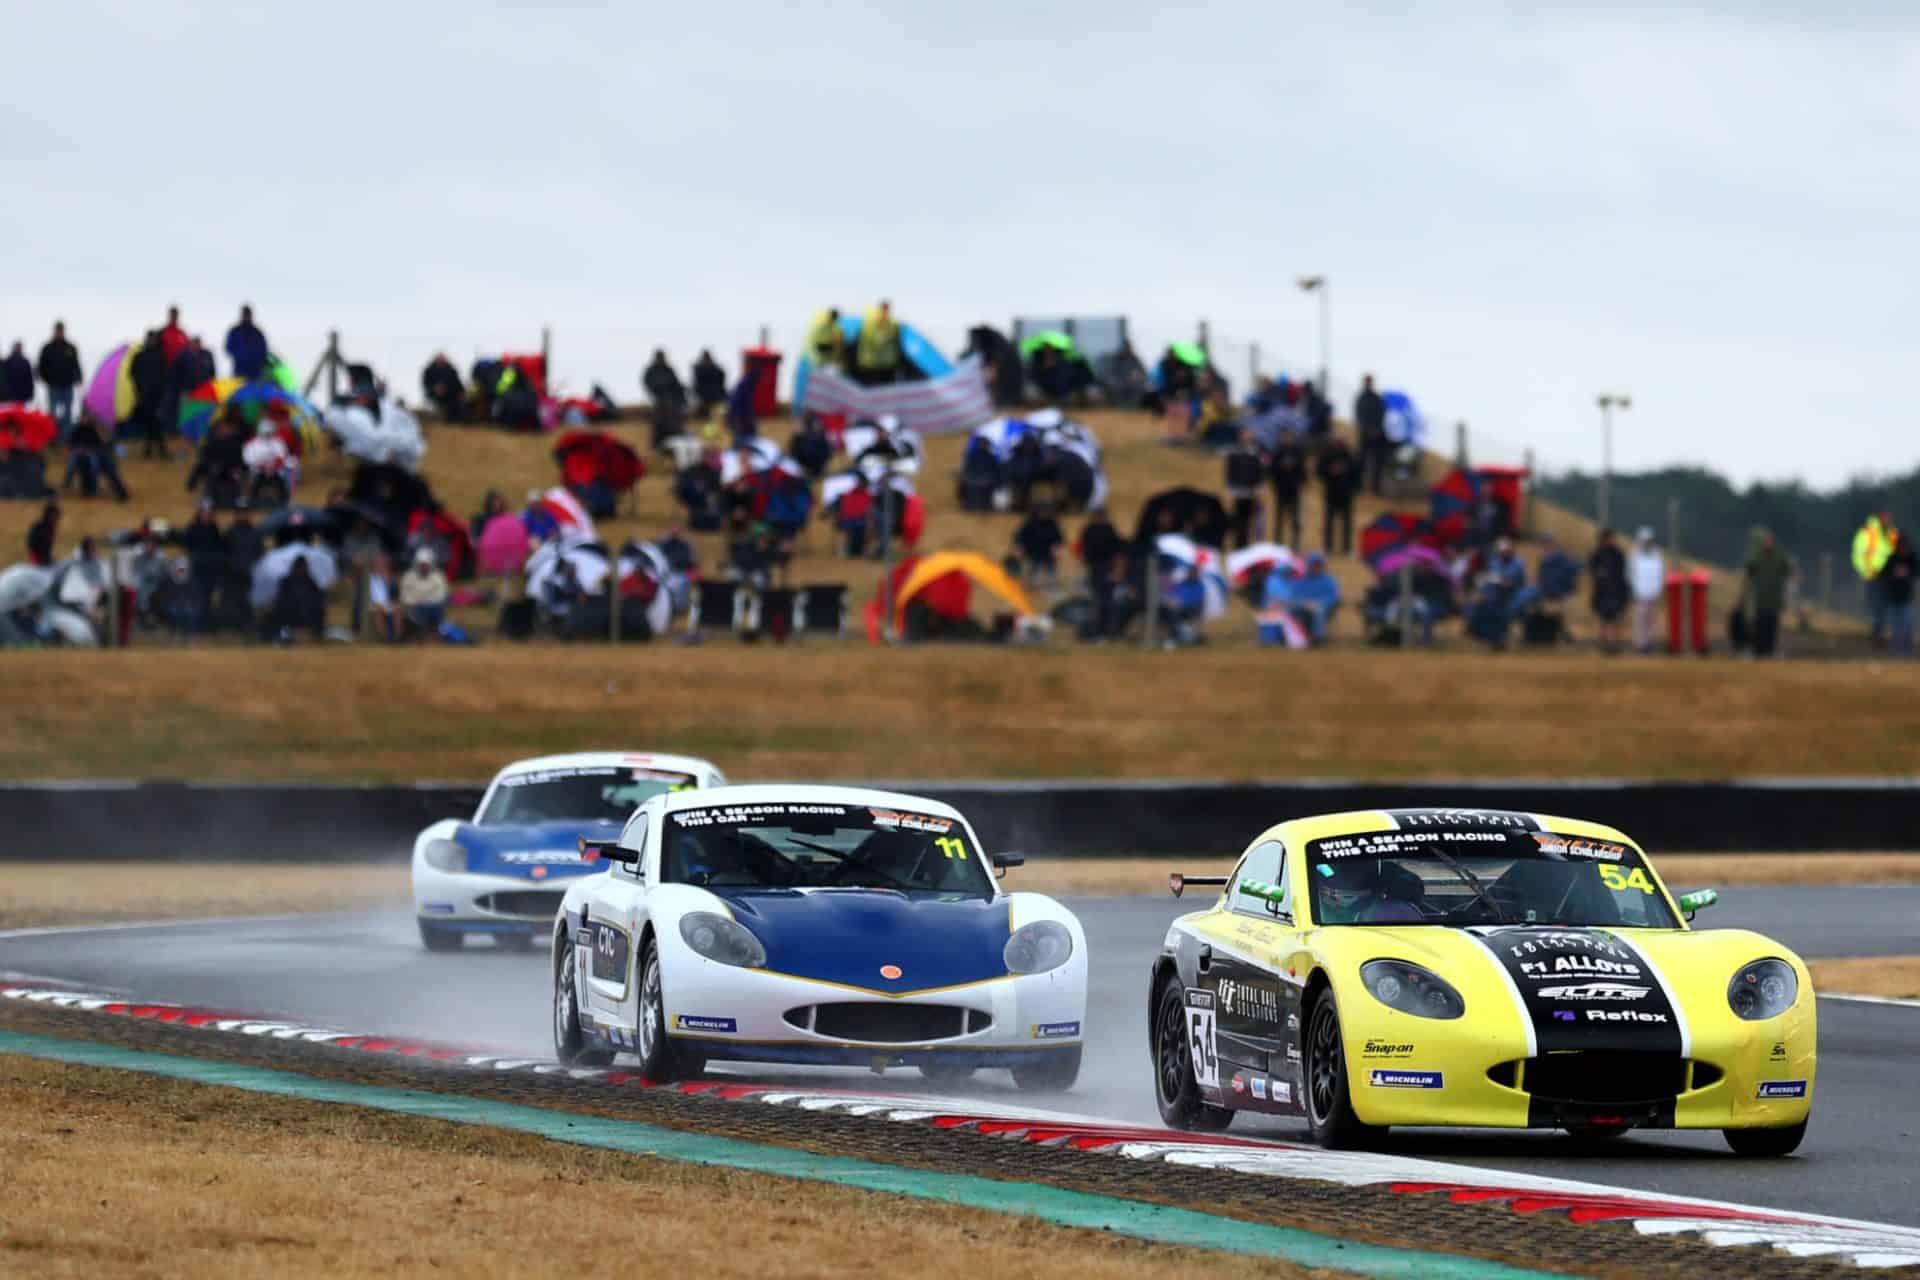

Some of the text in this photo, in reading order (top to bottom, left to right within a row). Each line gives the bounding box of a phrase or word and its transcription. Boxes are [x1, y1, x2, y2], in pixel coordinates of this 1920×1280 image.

[673, 806, 846, 822] WIN A SEASON RACING
[680, 816, 713, 827] THIS
[717, 815, 748, 824] CAR
[934, 836, 967, 860] 11
[1320, 832, 1507, 850] WIN A SEASON RACING
[1322, 847, 1361, 859] THIS
[1365, 843, 1400, 854] CAR
[1598, 863, 1655, 895] 54
[1520, 955, 1641, 974] F1 ALLOYS
[1586, 1010, 1667, 1023] Reflex
[1192, 1013, 1217, 1081] 54
[1363, 1043, 1414, 1054] Snap-on
[1385, 1075, 1434, 1084] MICHELIN
